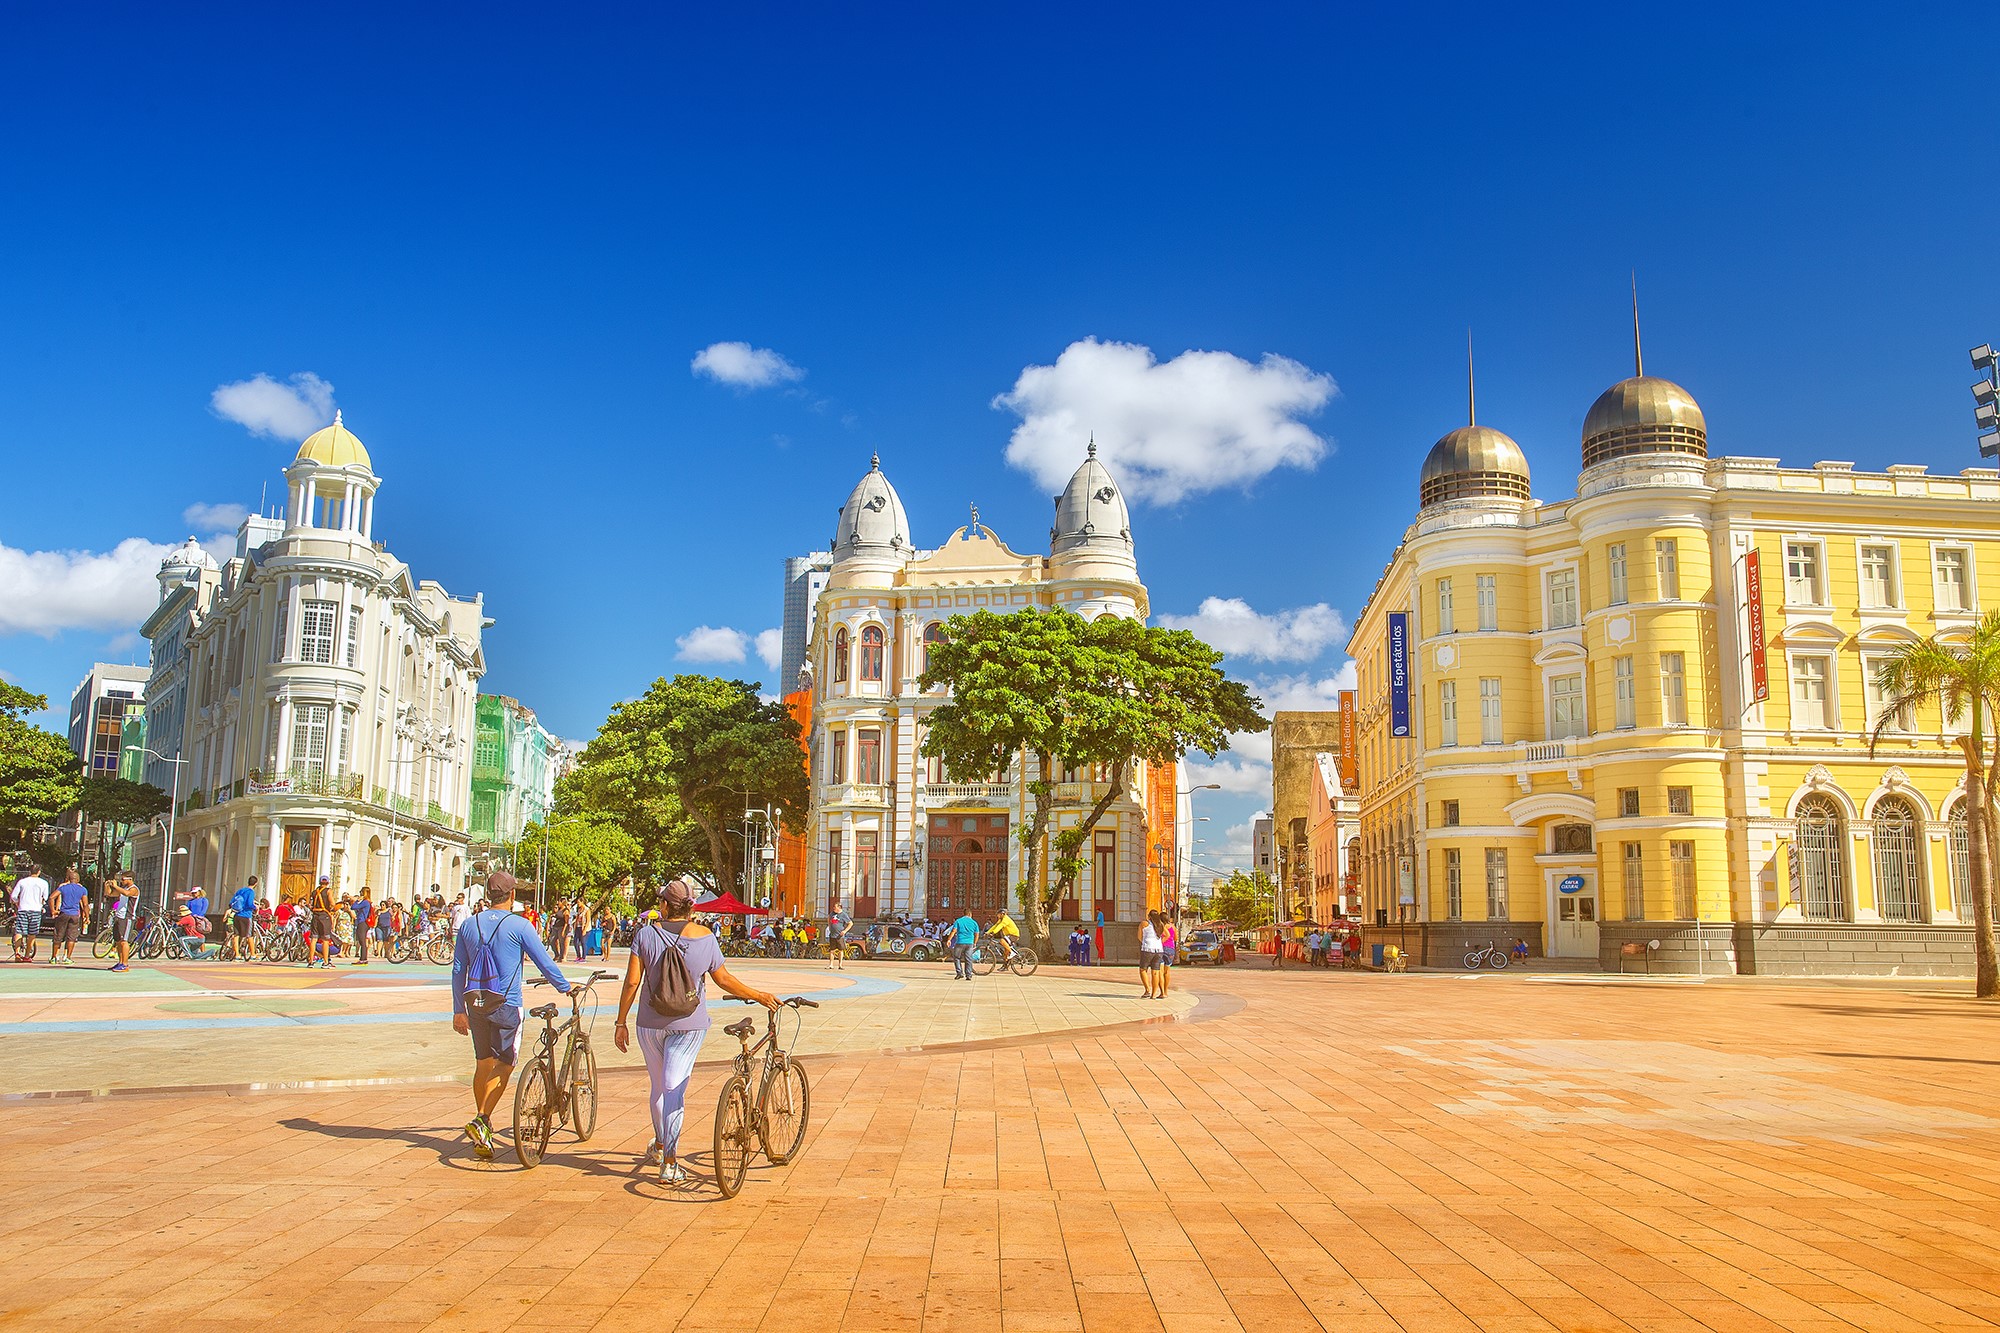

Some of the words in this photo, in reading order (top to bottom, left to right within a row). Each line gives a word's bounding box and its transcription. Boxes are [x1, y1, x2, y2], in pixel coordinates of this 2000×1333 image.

[1749, 565, 1758, 601] Caixa
[1751, 603, 1761, 647] Acervo
[1392, 625, 1405, 687] Espetáculos
[1343, 700, 1352, 759] Arte-Educação
